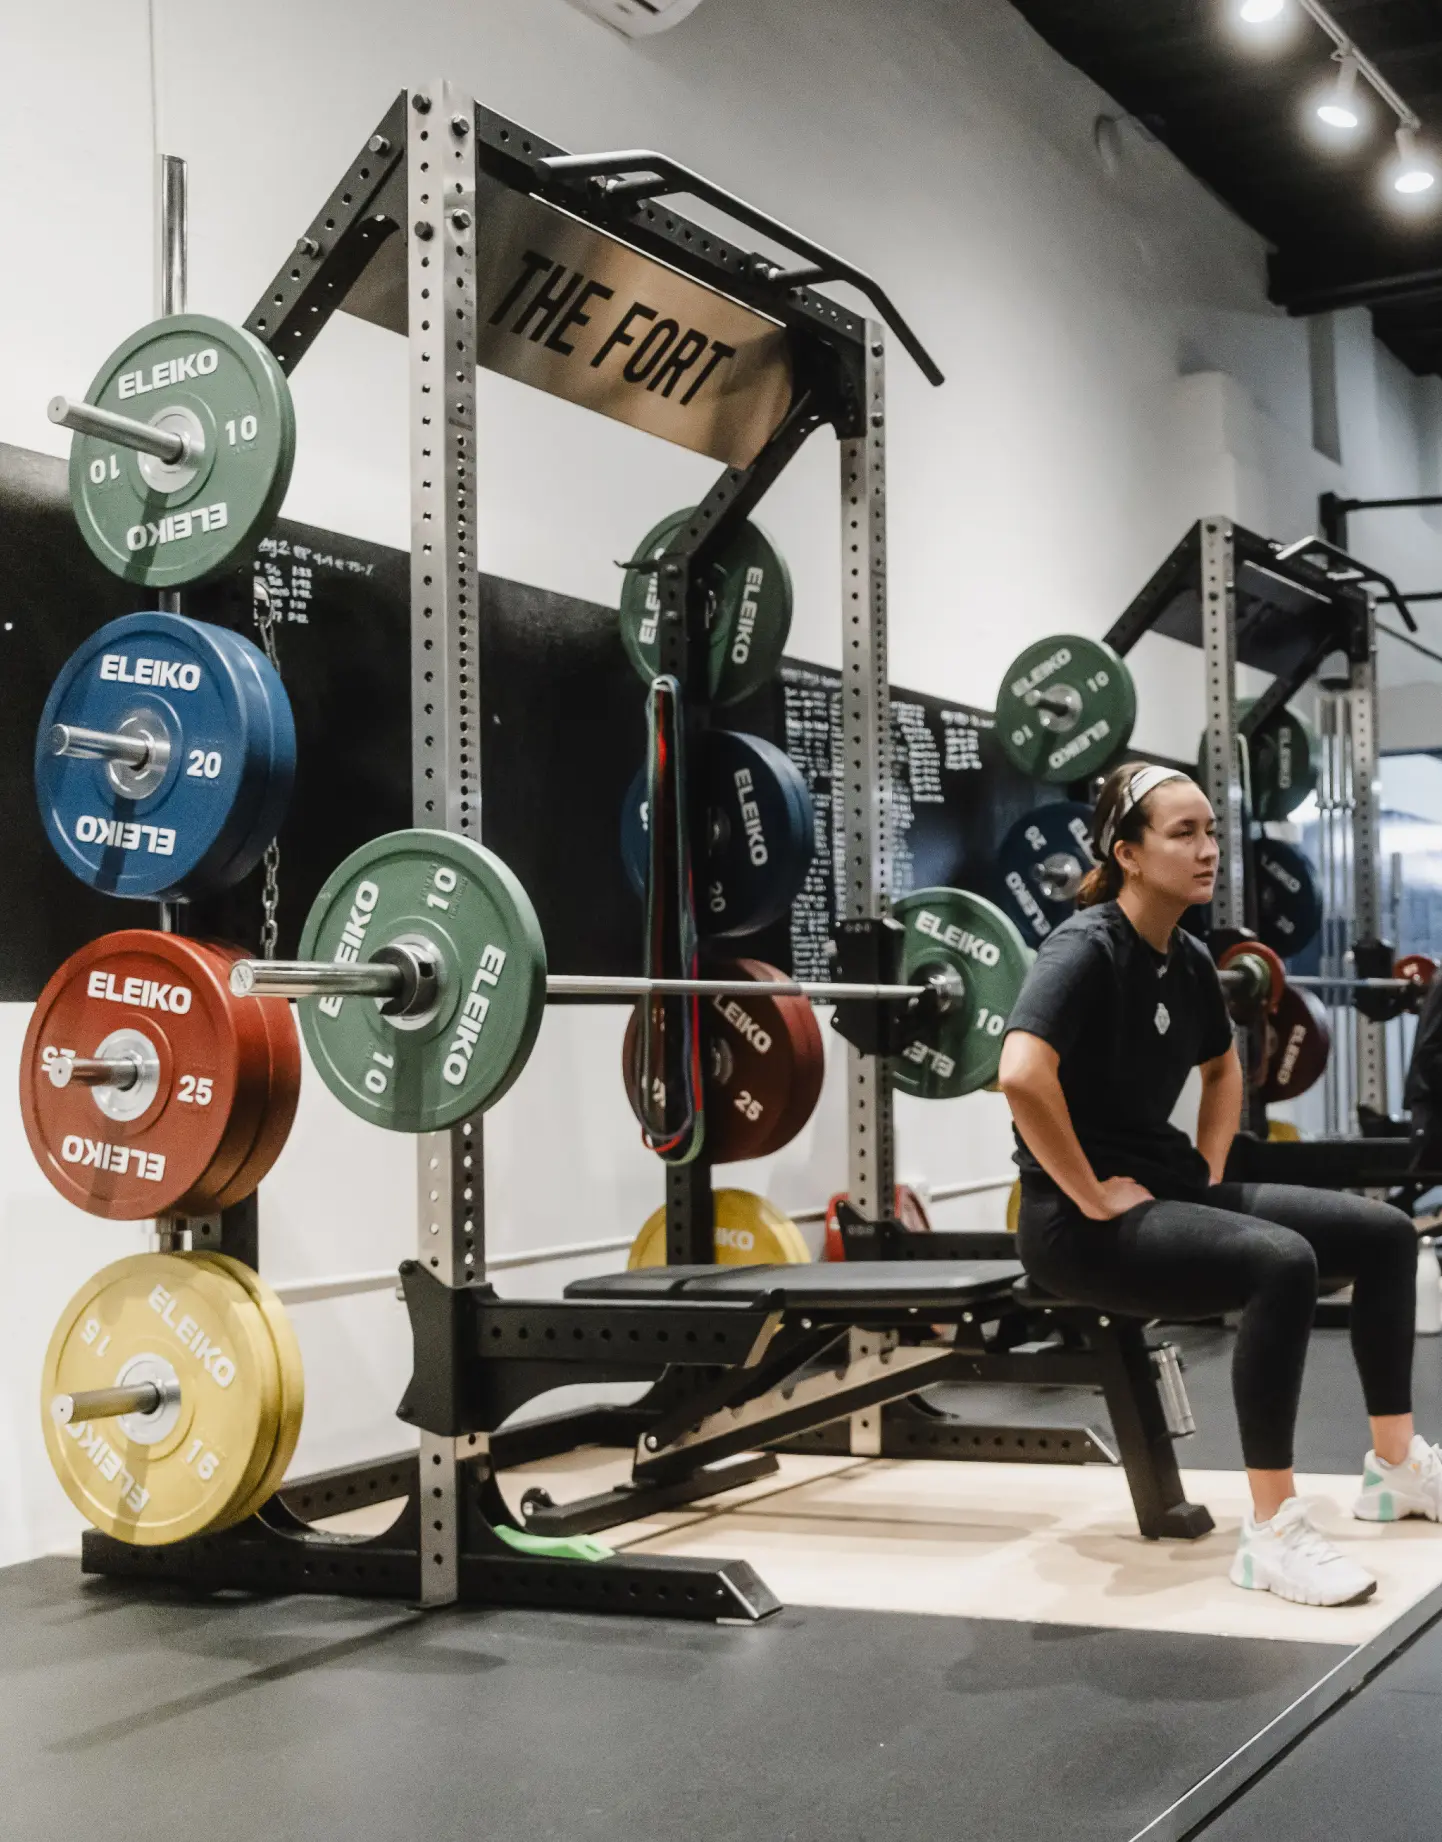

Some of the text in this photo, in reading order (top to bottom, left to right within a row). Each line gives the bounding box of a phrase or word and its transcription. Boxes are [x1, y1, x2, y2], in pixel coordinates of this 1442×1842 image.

[488, 249, 736, 406] THE FORT
[118, 348, 219, 400] ELEIKO
[225, 414, 258, 446] 10
[89, 452, 121, 484] 10
[126, 502, 228, 551] ELEIKO
[731, 566, 764, 664] ELEIKO
[100, 653, 202, 692] ELEIKO
[1011, 648, 1072, 698] ELEIKO
[1086, 670, 1110, 693] 10
[186, 749, 222, 779] 20
[1048, 718, 1111, 770] ELEIKO
[75, 814, 177, 857] ELEIKO
[733, 767, 768, 867] ELEIKO
[426, 866, 458, 912] 10
[318, 880, 380, 1019] EEIKO
[914, 909, 1001, 967] ELEIKO
[87, 970, 192, 1015] ELEIKO
[442, 944, 507, 1087] ELEIKO
[713, 993, 773, 1054] LEIKO
[976, 1008, 1006, 1037] 10
[176, 1074, 214, 1107] 25
[364, 1050, 395, 1095] 10
[733, 1089, 764, 1122] 25
[61, 1134, 167, 1182] ELEIKO
[80, 1317, 112, 1358] 15
[148, 1283, 237, 1389] ELEIKO
